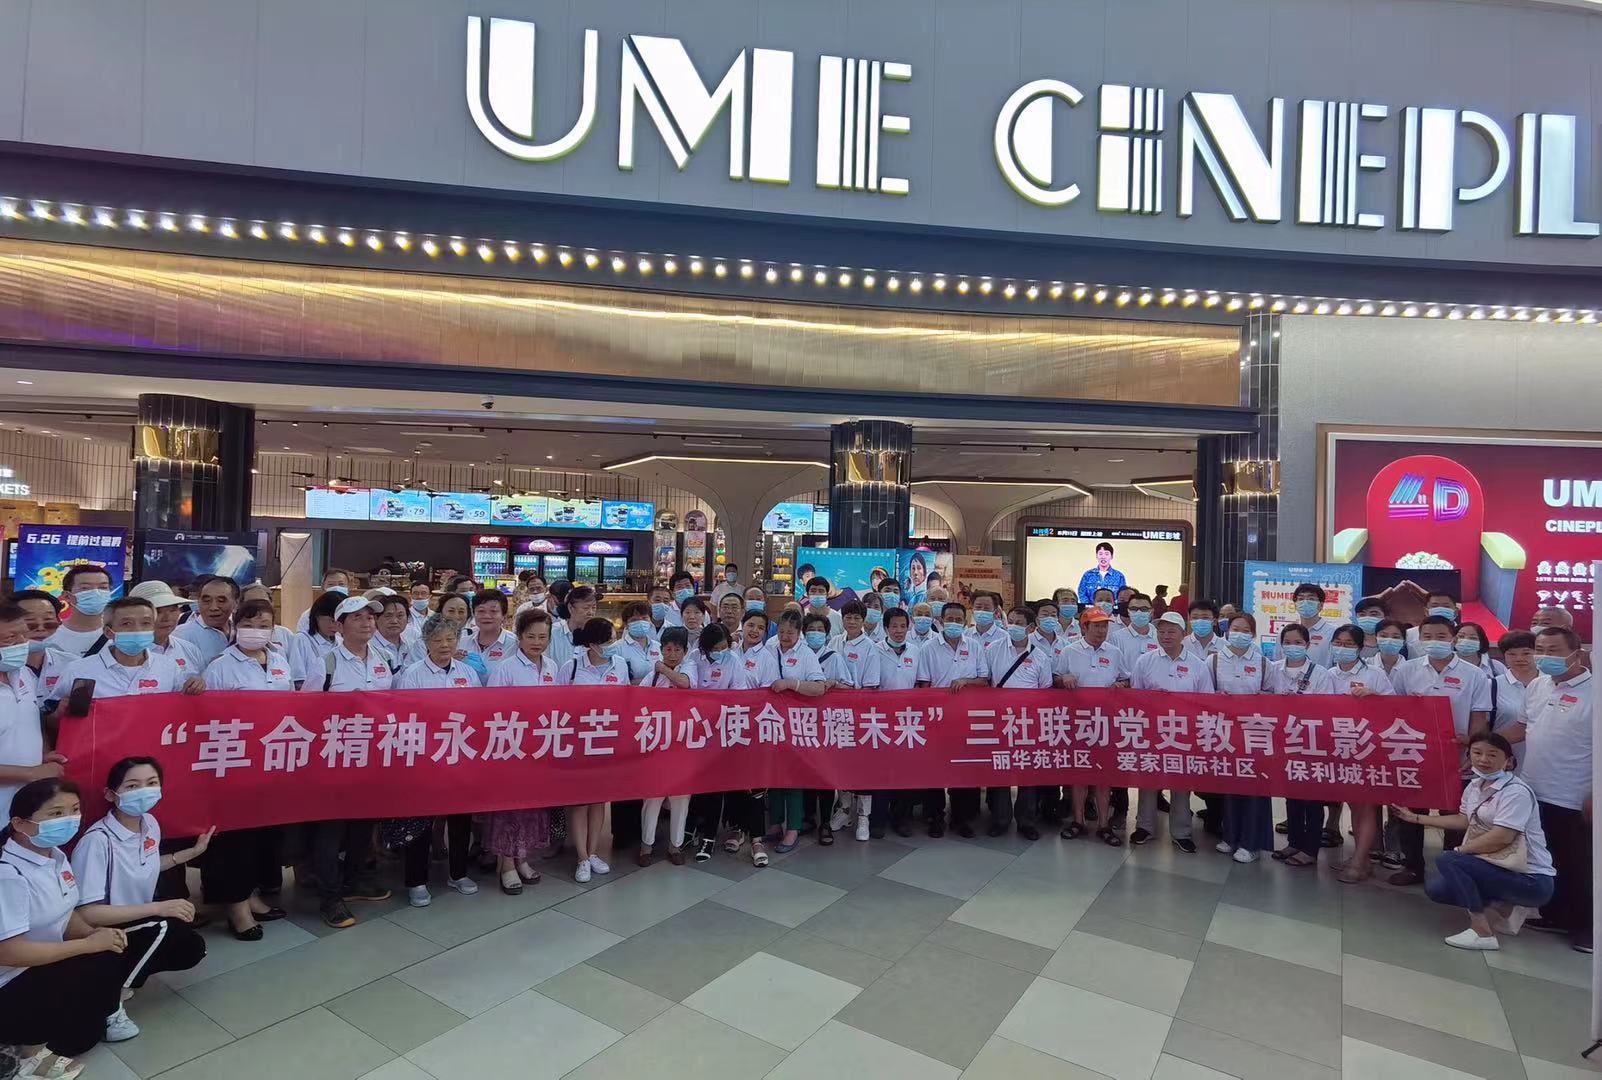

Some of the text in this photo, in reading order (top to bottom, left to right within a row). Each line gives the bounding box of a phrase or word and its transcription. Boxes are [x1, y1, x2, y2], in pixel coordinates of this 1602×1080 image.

[465, 14, 912, 195] UME
[26, 533, 62, 545] 6.26
[161, 702, 1427, 778] “革命精神永放光芒 初心使命照耀未来” 三社联动党史教育红影会
